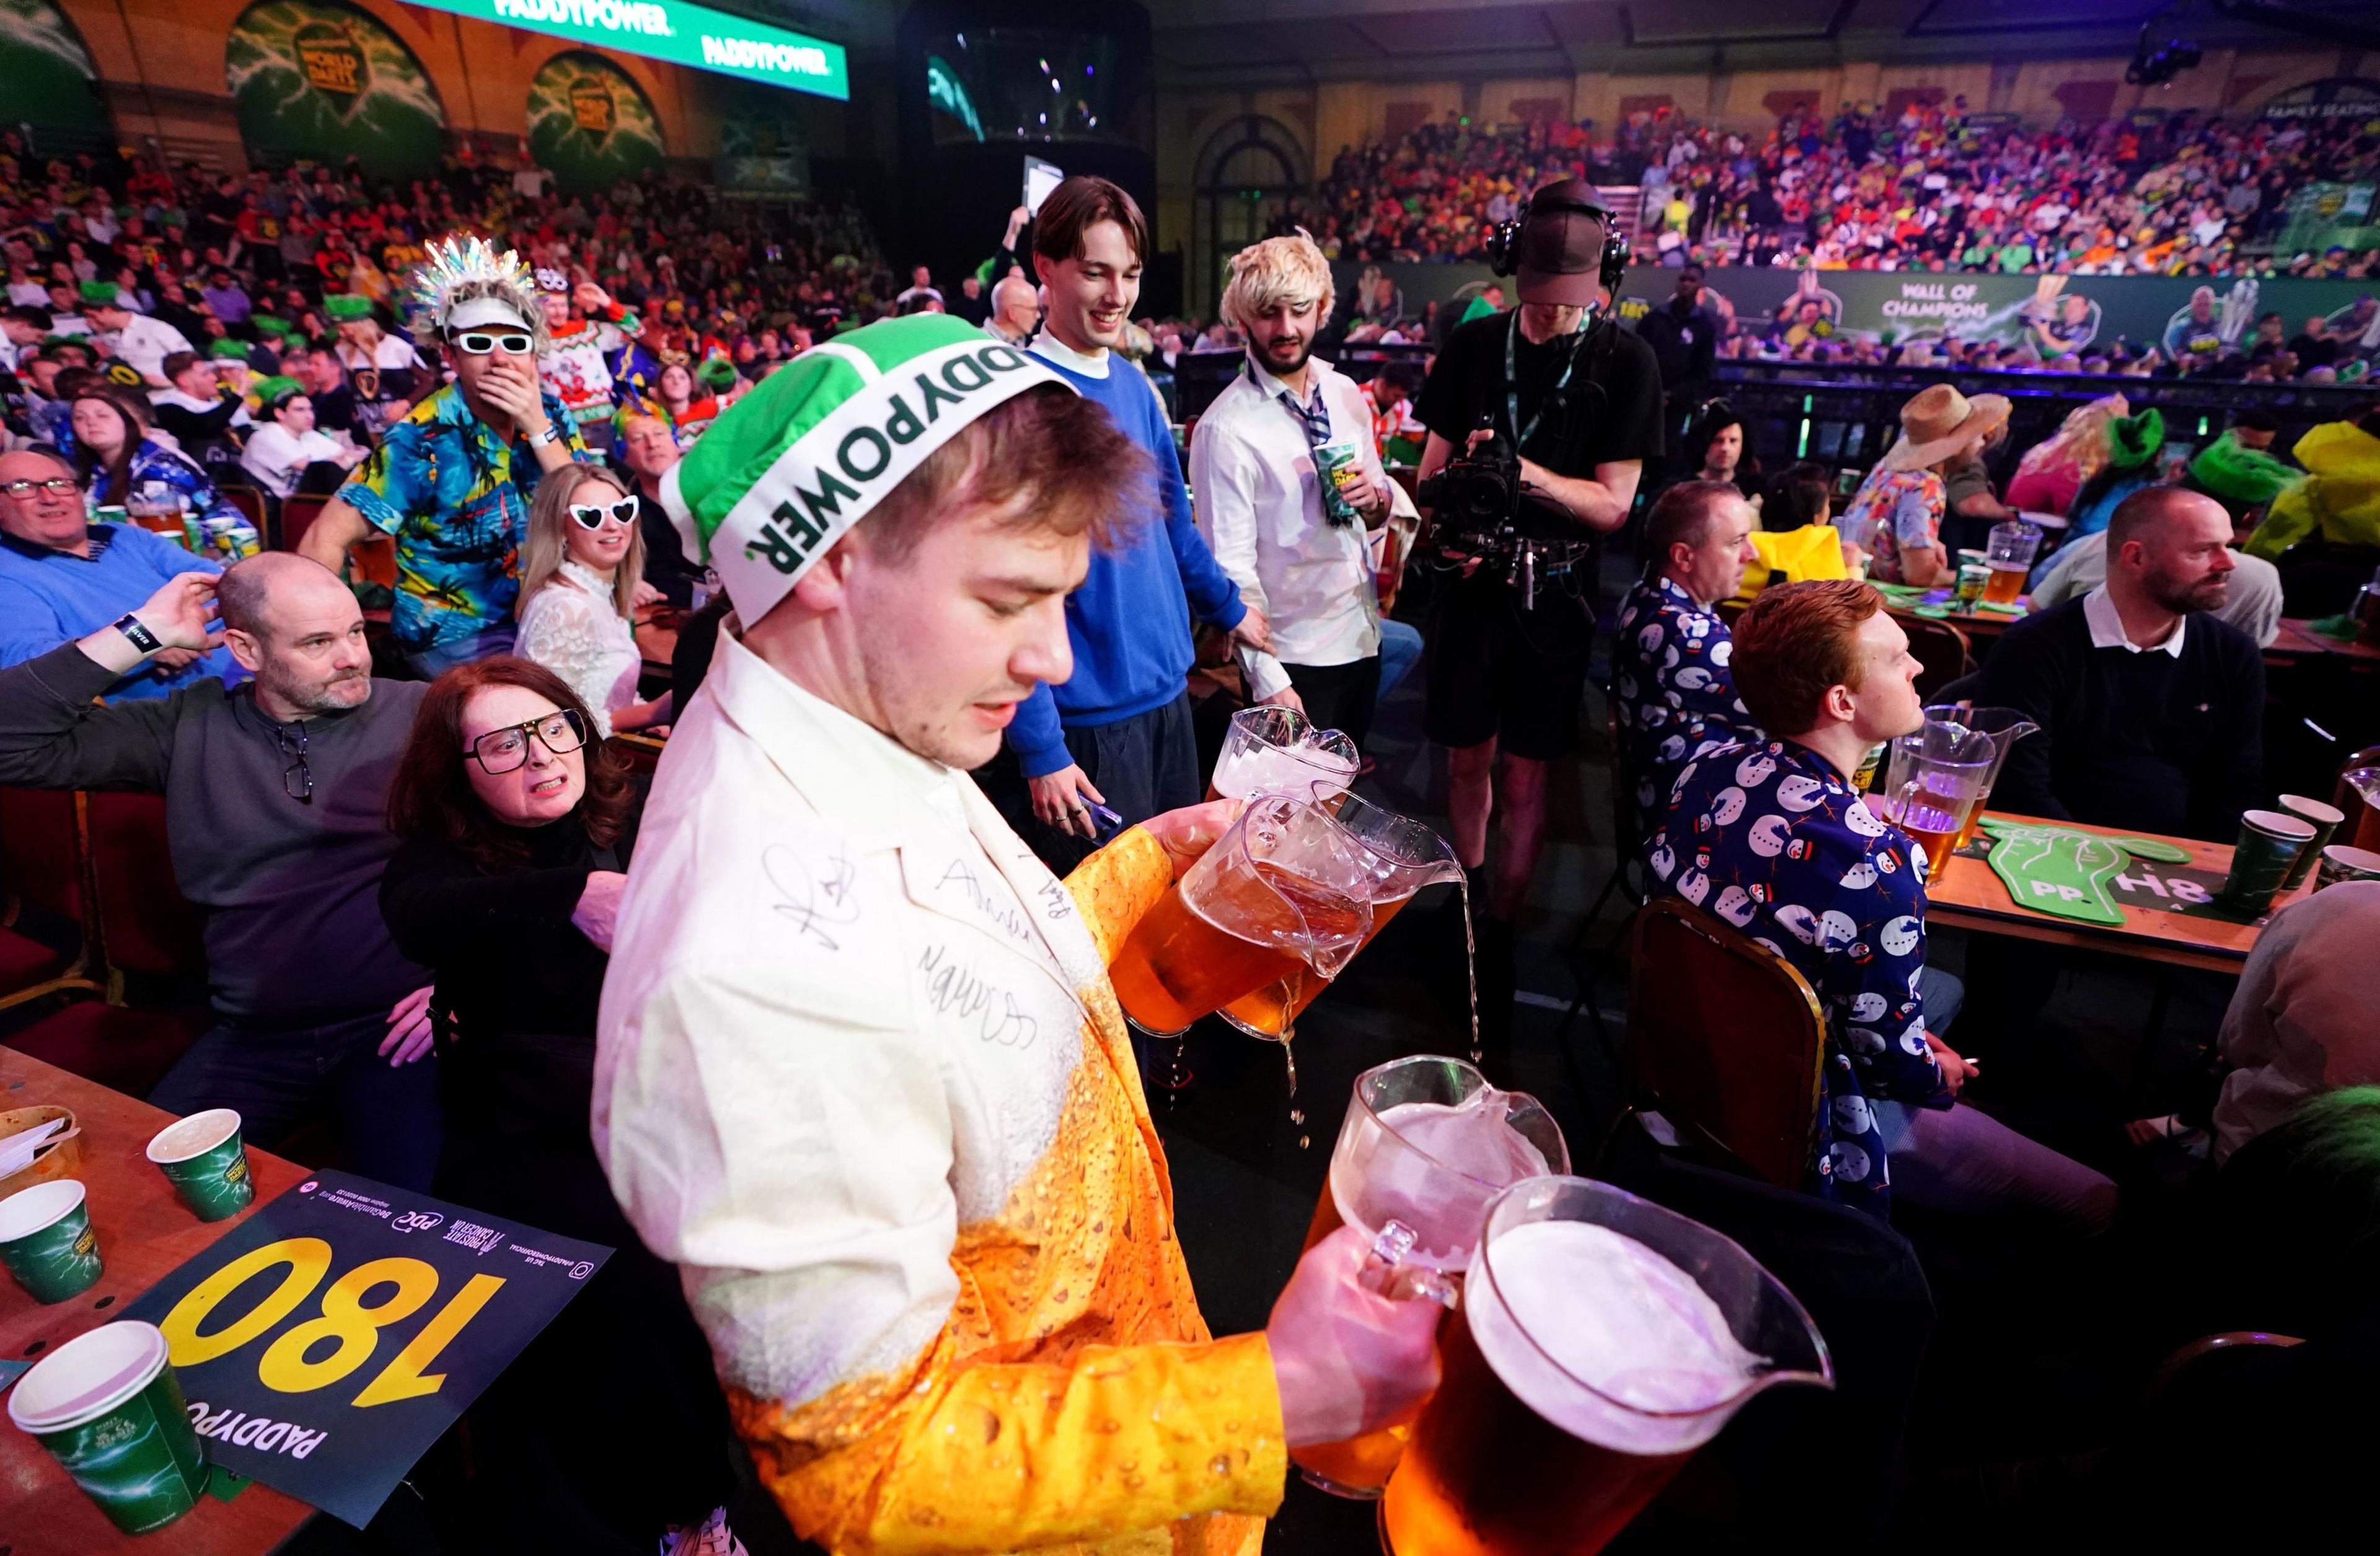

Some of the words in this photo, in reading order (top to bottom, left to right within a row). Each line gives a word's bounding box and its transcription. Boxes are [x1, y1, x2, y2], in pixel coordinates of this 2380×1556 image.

[1901, 283, 1946, 300] WALL
[1950, 283, 1978, 301] OF
[1882, 300, 1989, 319] CHAMPIONS
[128, 625, 151, 645] SILVER
[2115, 872, 2215, 903] H8
[319, 1190, 392, 1219] BeGambleAware.org
[398, 1211, 438, 1230] PDC
[449, 1219, 465, 1230] UK
[461, 1221, 495, 1239] CANCER
[443, 1229, 487, 1250] PROSTATE
[509, 1244, 575, 1267] @PADDYPOWEROFFICIAL
[534, 1259, 545, 1267] TAG
[160, 1237, 507, 1407] 180
[187, 1402, 328, 1459] PADDYPO
